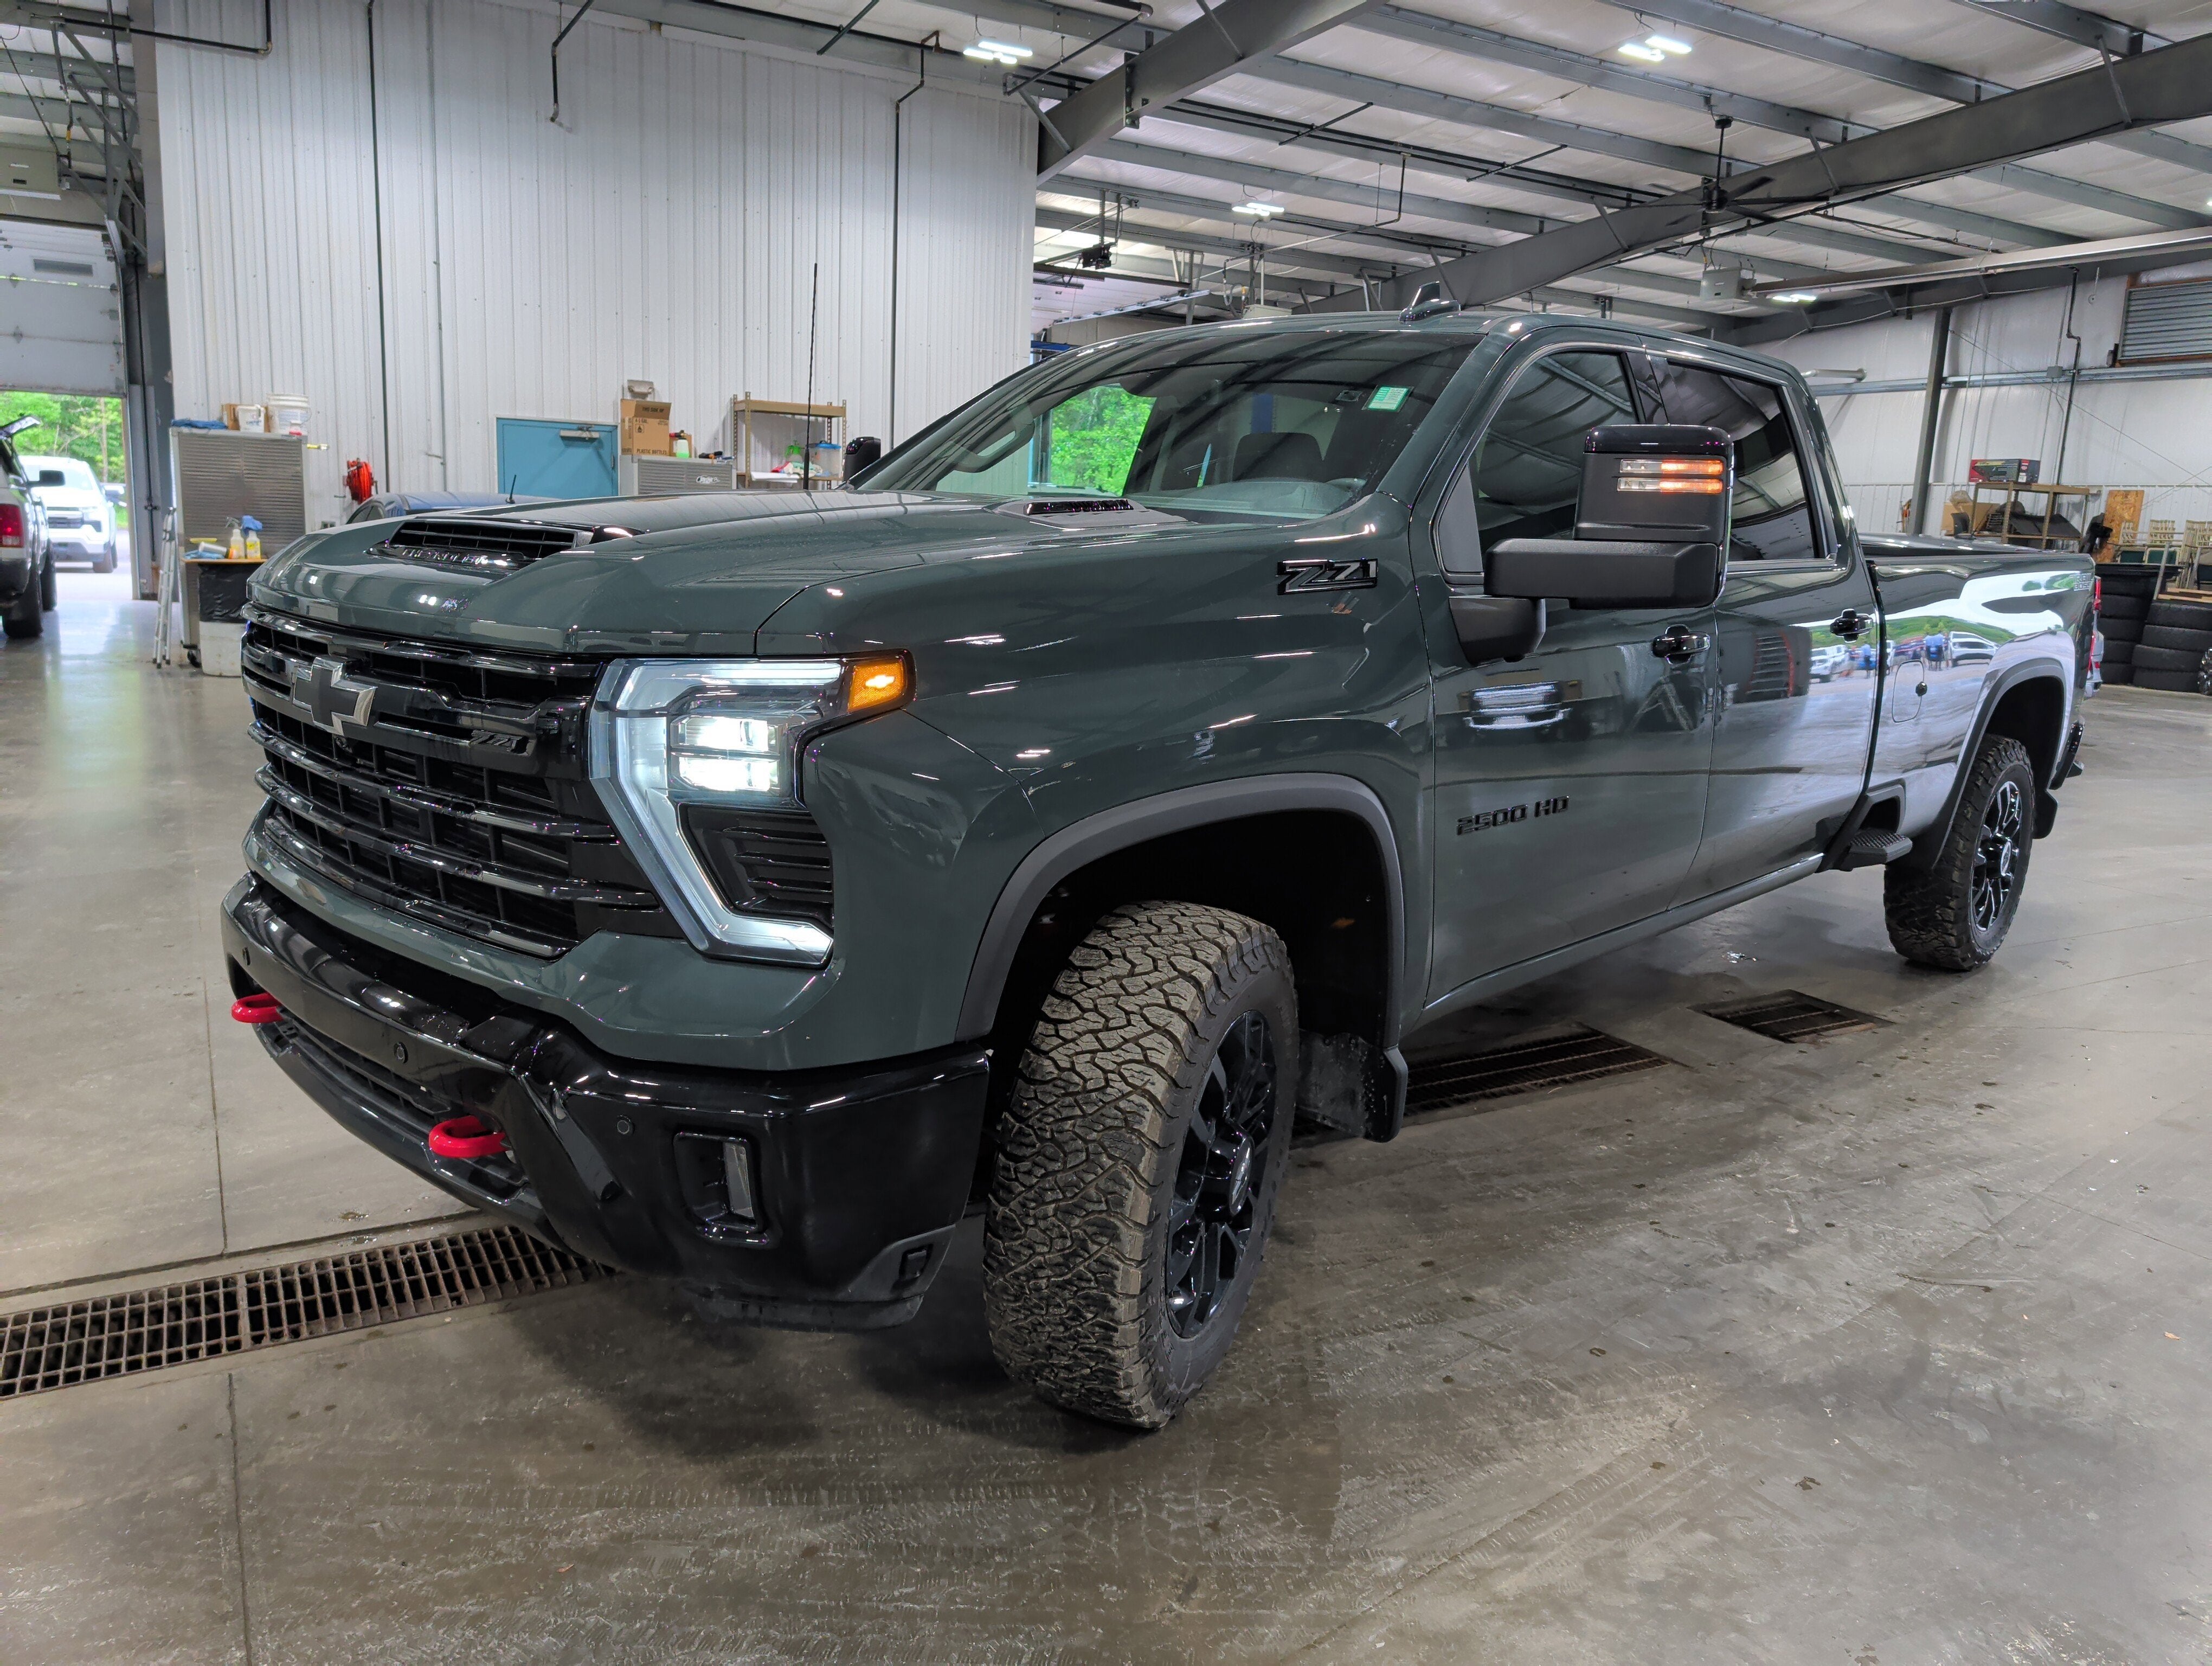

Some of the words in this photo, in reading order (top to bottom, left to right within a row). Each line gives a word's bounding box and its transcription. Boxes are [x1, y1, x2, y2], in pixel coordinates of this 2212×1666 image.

[1277, 559, 1378, 595] Z71
[2069, 573, 2094, 584] TRAIL
[2073, 582, 2093, 592] BOSS
[1456, 804, 1528, 835] 2500
[1534, 794, 1570, 818] HD
